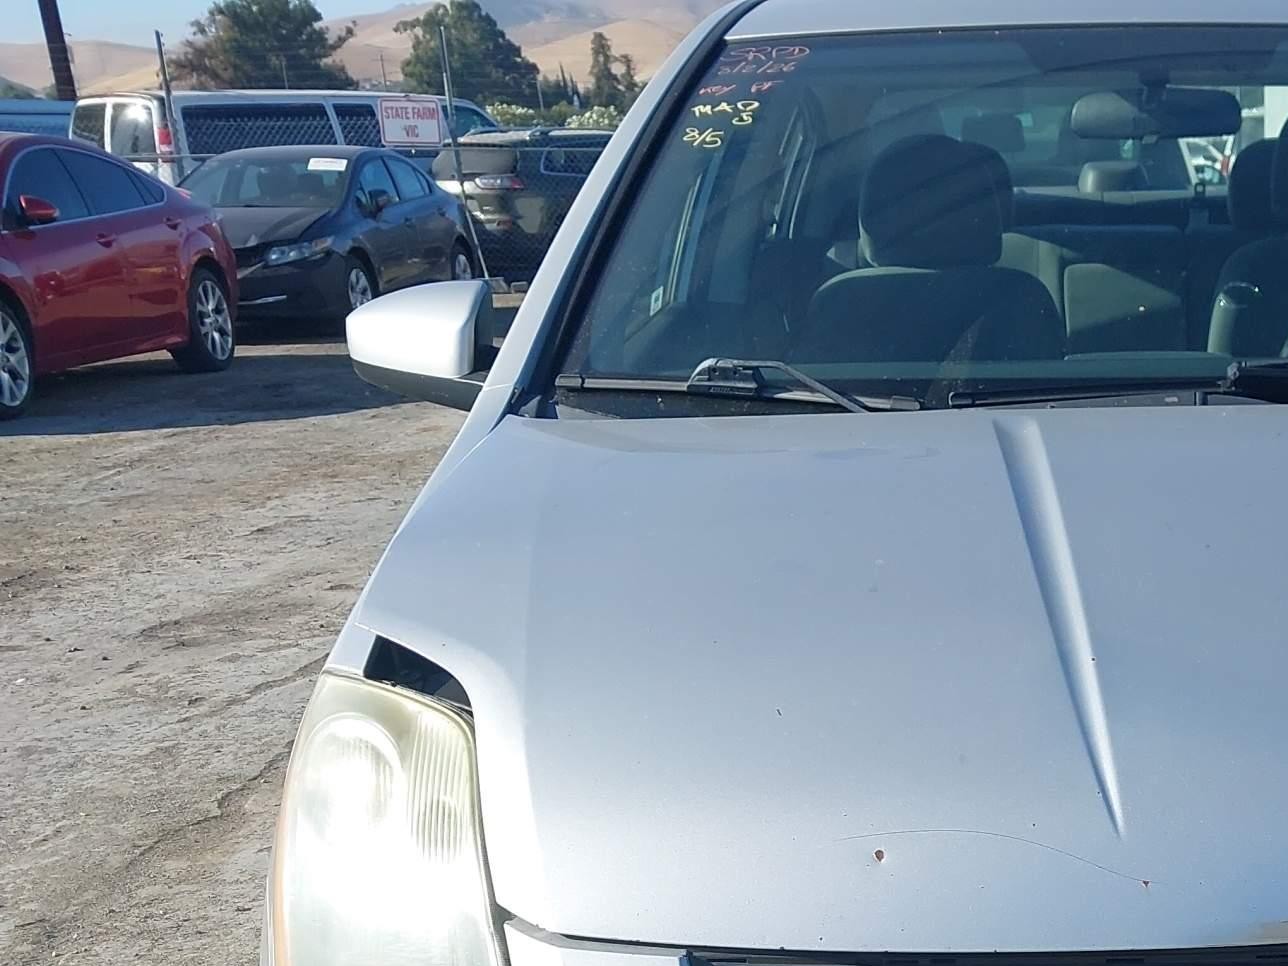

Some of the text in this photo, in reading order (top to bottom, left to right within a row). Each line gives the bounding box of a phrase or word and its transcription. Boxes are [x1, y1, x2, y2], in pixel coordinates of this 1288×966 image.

[384, 106, 438, 121] STATE FARM
[682, 127, 725, 148] 8/5
